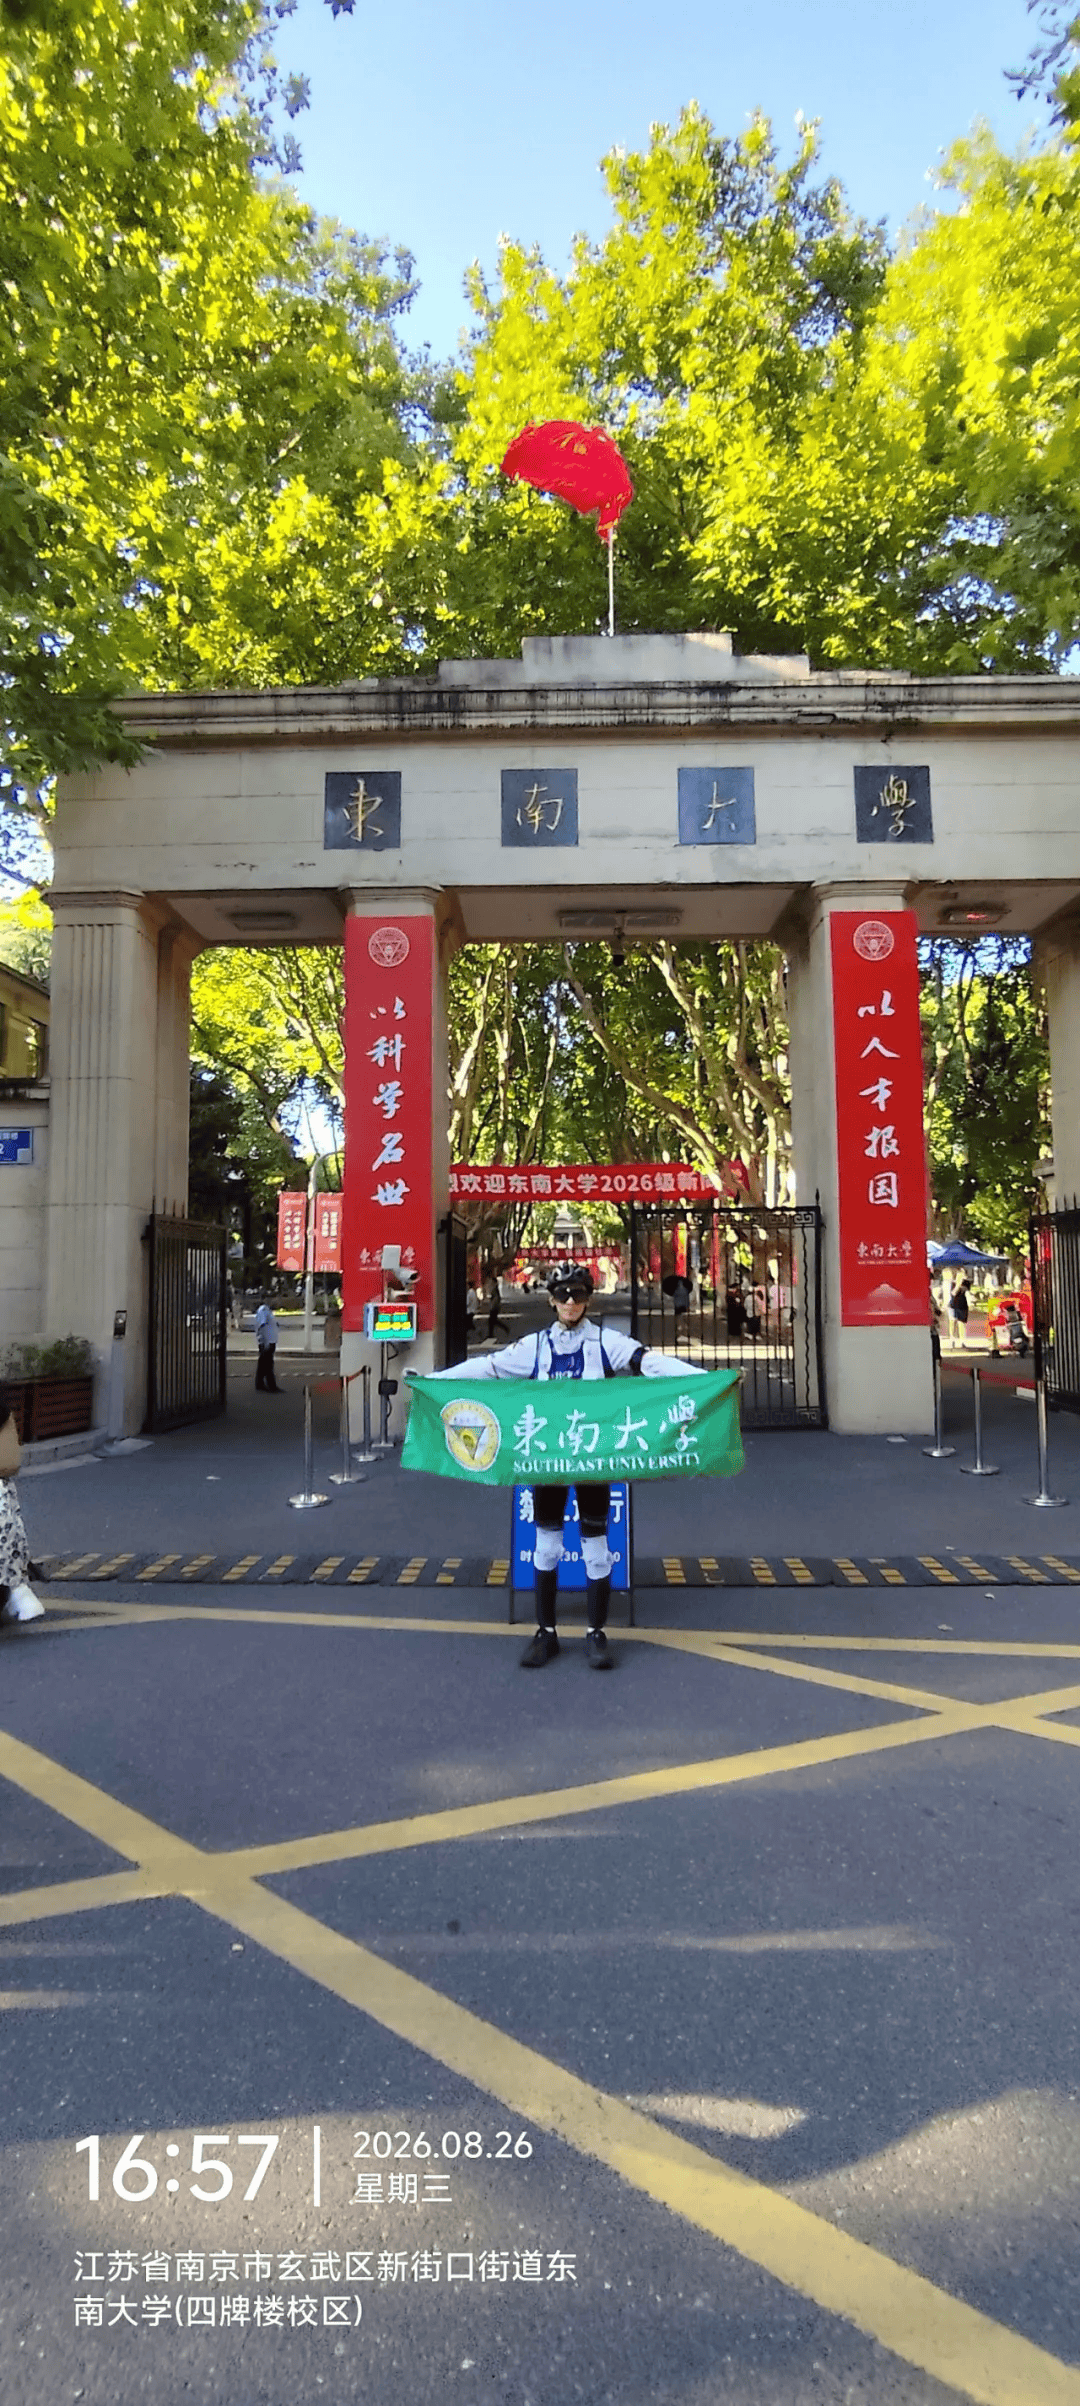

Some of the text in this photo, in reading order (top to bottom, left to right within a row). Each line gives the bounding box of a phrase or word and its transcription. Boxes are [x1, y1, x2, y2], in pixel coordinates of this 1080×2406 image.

[857, 989, 901, 1208] 以人才报国
[448, 1169, 743, 1194] 欢迎东南大学2026级新
[513, 1452, 700, 1473] SOUTHEAST UNIVERSITY
